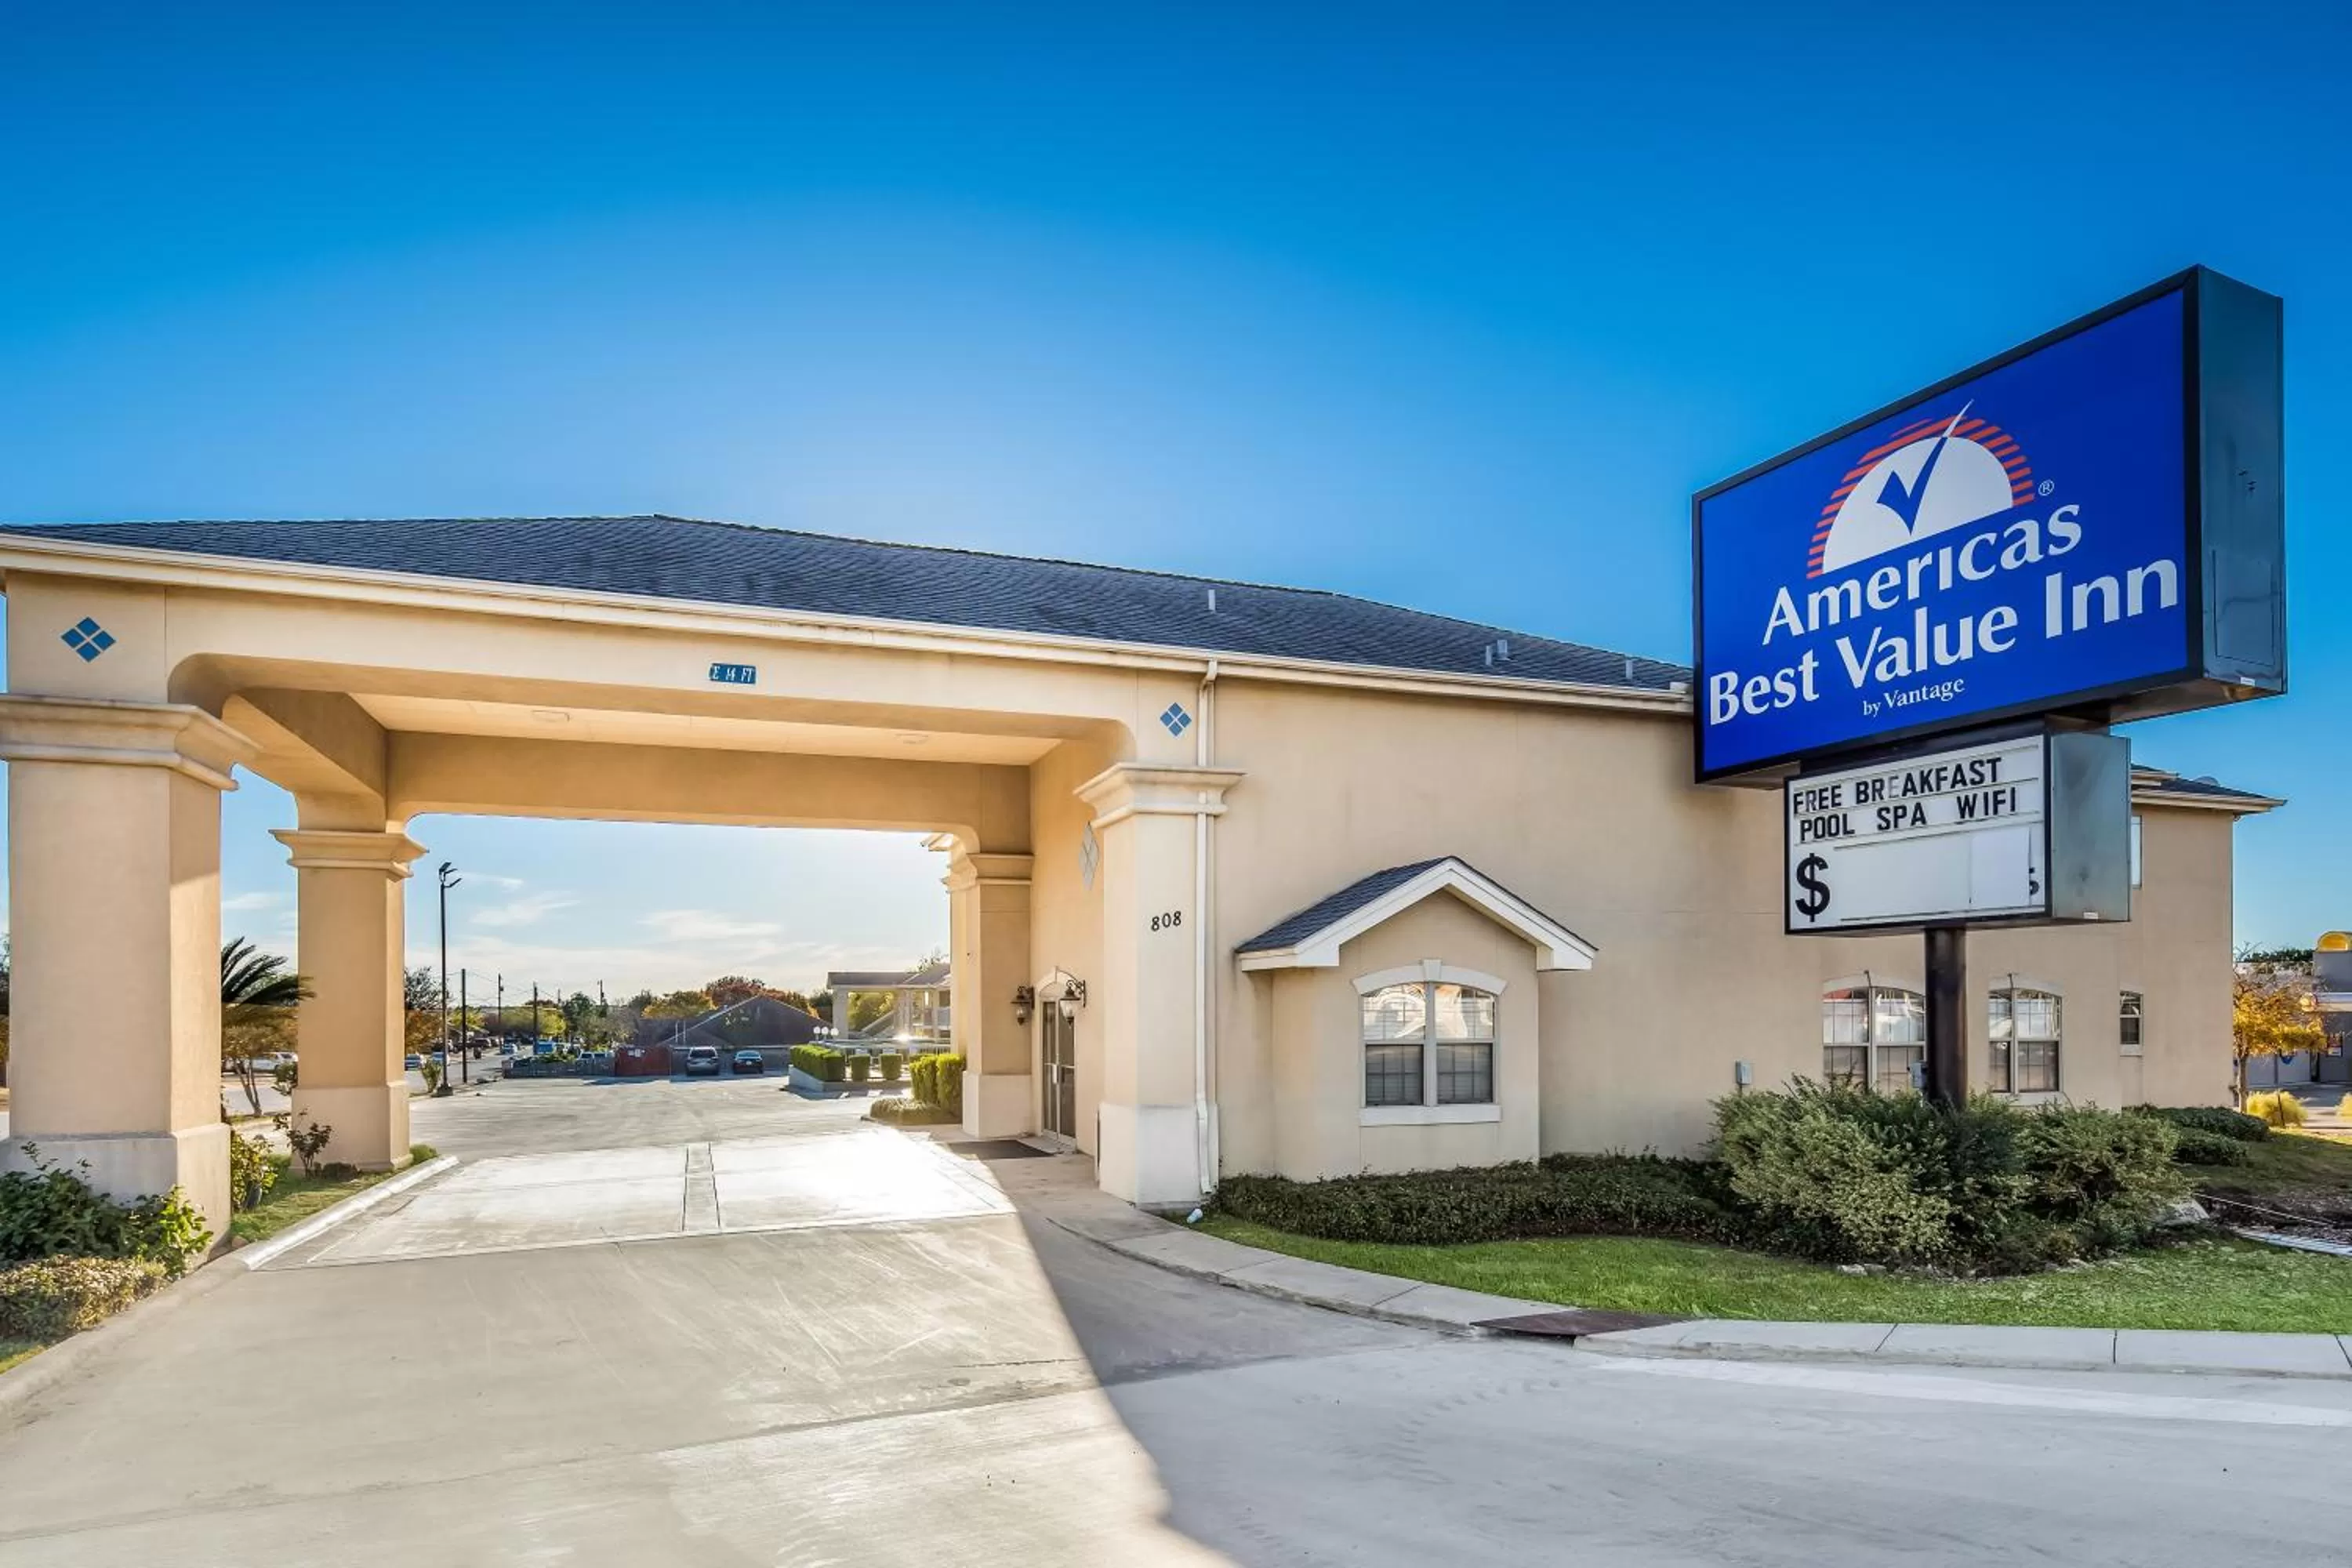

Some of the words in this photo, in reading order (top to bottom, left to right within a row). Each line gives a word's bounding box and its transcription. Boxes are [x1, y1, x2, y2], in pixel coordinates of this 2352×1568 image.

[1762, 504, 2082, 645] Americas
[1710, 649, 1820, 725] Best
[1835, 607, 2018, 689] Value
[2045, 559, 2177, 639] Inn
[1863, 700, 1882, 718] by
[1883, 678, 1965, 708] Vantage
[1793, 785, 1842, 815] FREE
[1855, 757, 2002, 806] BREAKFAST
[1800, 813, 1855, 842] POOL
[1876, 802, 1927, 831] SPA
[1956, 786, 2016, 819] WIFI
[1795, 852, 1831, 923] $
[1151, 910, 1181, 931] 808
